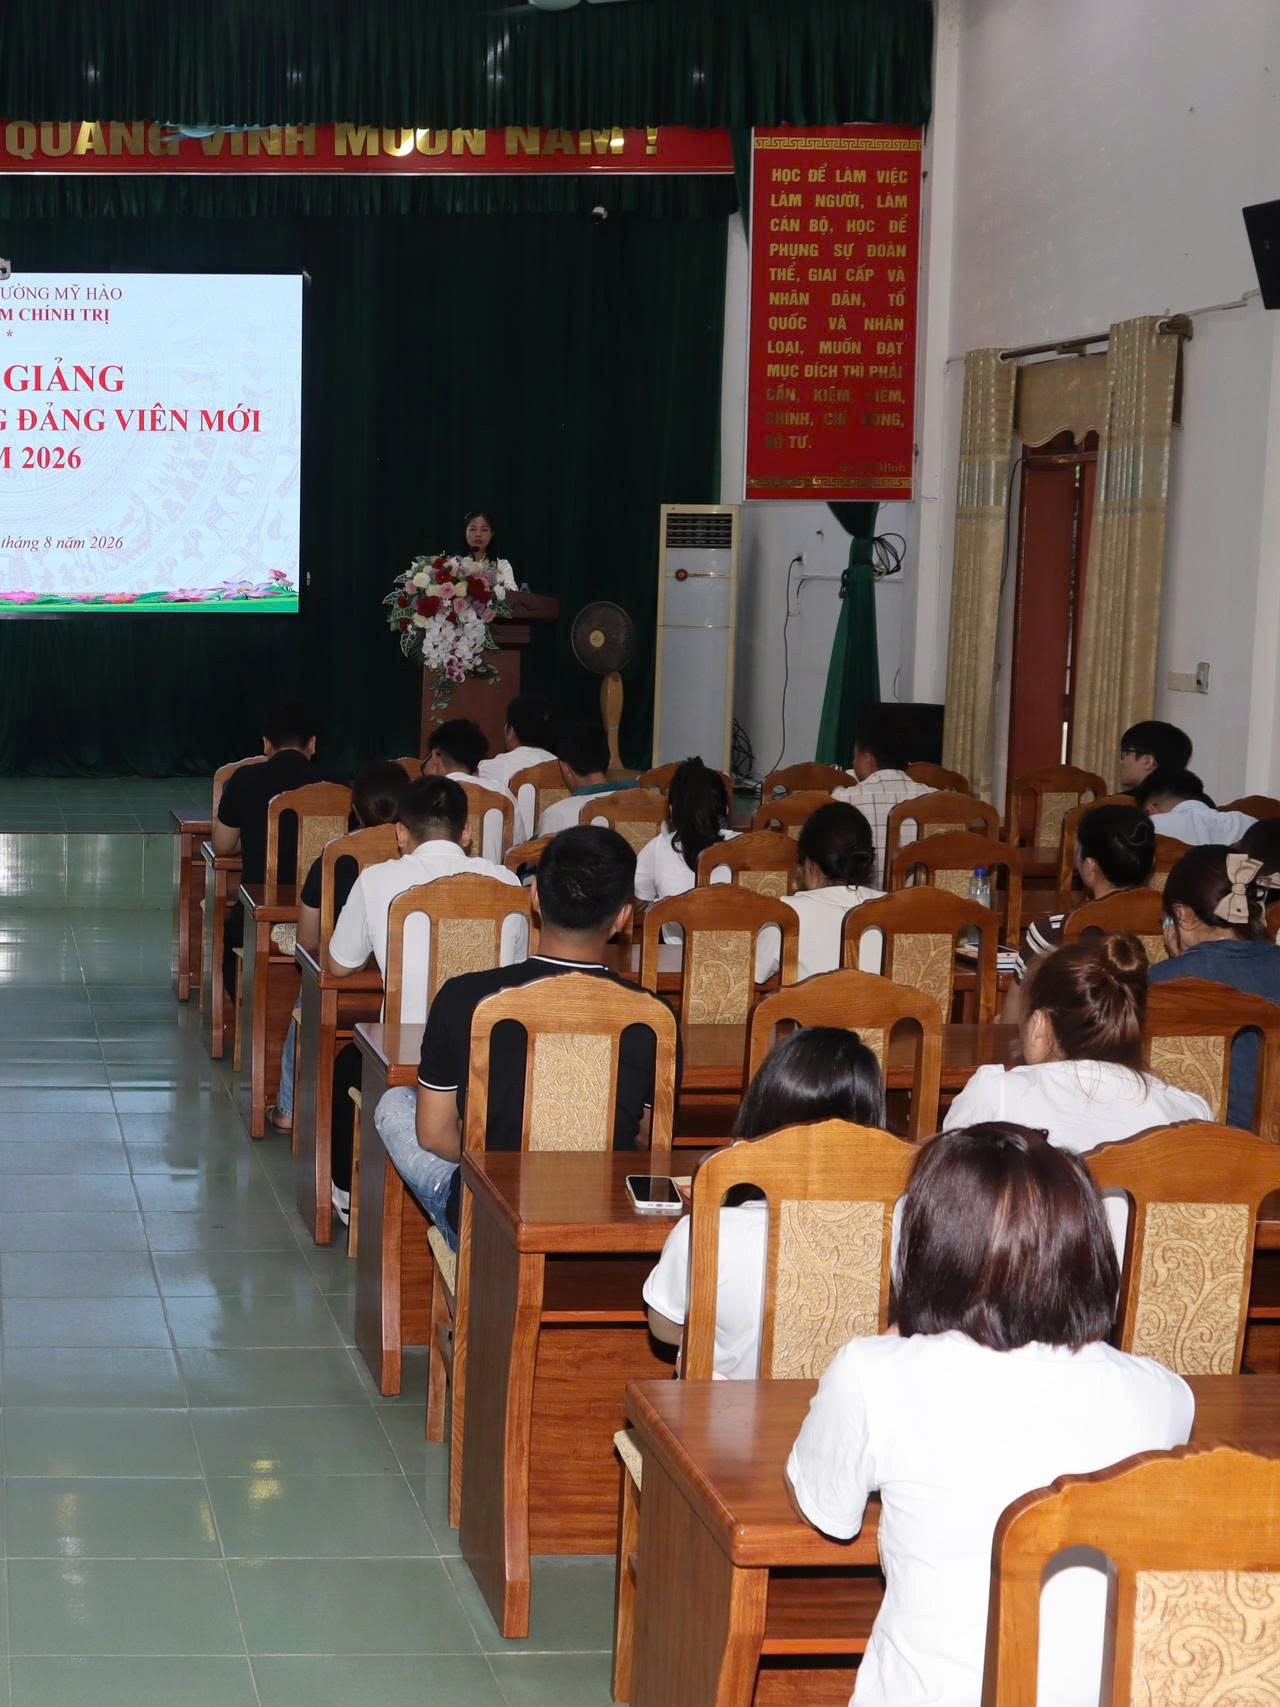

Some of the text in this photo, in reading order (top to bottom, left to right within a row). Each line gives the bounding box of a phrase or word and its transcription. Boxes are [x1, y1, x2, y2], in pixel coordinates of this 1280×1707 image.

[5, 119, 181, 160] QUANG
[772, 163, 908, 187] HỌC ĐỂ LÀM VIỆC
[770, 190, 908, 209] LÀM NGƯỜI, LÀM
[770, 215, 800, 232] CÁN
[846, 219, 876, 236] HỌC
[889, 213, 909, 233] ĐỂ
[769, 241, 907, 260] PHỤNG SỰ ĐOÀN
[769, 262, 905, 283] THỂ, GIAI CẤP VÀ
[55, 284, 81, 300] MỸ
[86, 283, 123, 300] HÀO
[769, 290, 810, 306] NHÂN
[888, 287, 906, 307] TỔ
[18, 304, 75, 321] CHÍNH
[80, 308, 111, 325] TRỊ
[768, 312, 904, 331] QUỐC VÀ NHÂN
[767, 337, 904, 358] LOẠI, MUỐN ĐẠT
[3, 356, 126, 392] GIẢNG
[767, 364, 800, 380] MỤC
[804, 361, 838, 378] ĐÍCH
[843, 362, 864, 378] THÌ
[16, 401, 106, 432] ĐẢNG
[114, 402, 190, 432] VIÊN
[199, 402, 262, 433] MỚI
[21, 446, 82, 469] 2026
[1, 536, 39, 552] tháng
[43, 536, 52, 549] 8
[56, 537, 86, 550] năm
[89, 536, 124, 549] 2026
